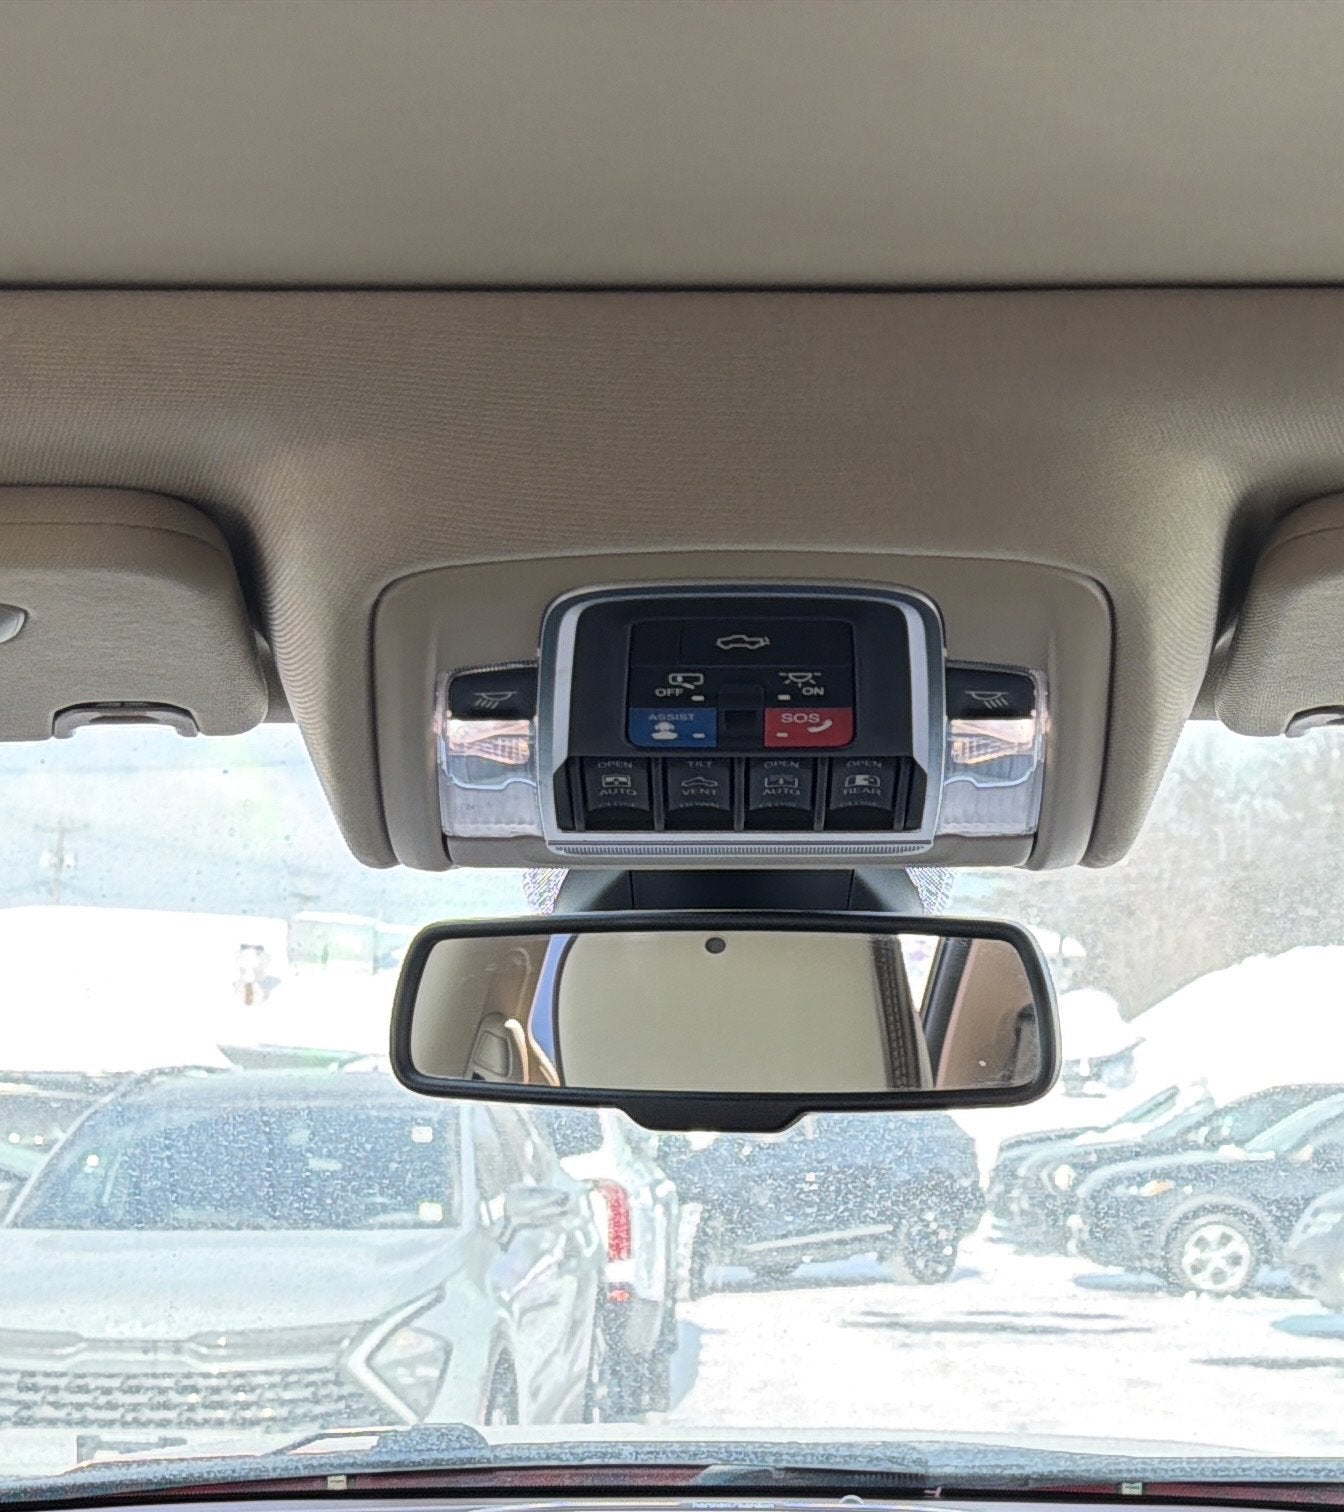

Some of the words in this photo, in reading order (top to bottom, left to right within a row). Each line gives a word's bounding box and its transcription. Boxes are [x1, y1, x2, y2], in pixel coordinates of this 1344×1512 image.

[655, 688, 684, 697] OFF
[802, 687, 825, 696] ON
[648, 713, 695, 722] ASSIST
[780, 713, 820, 723] SOS
[597, 760, 633, 769] OPEN
[687, 760, 712, 769] TILT
[763, 760, 800, 769] OPEN
[846, 760, 882, 769] OPEN
[599, 788, 637, 797] AUTO
[681, 788, 718, 796] VENT
[762, 788, 801, 797] AUTO
[843, 788, 882, 797] REAR
